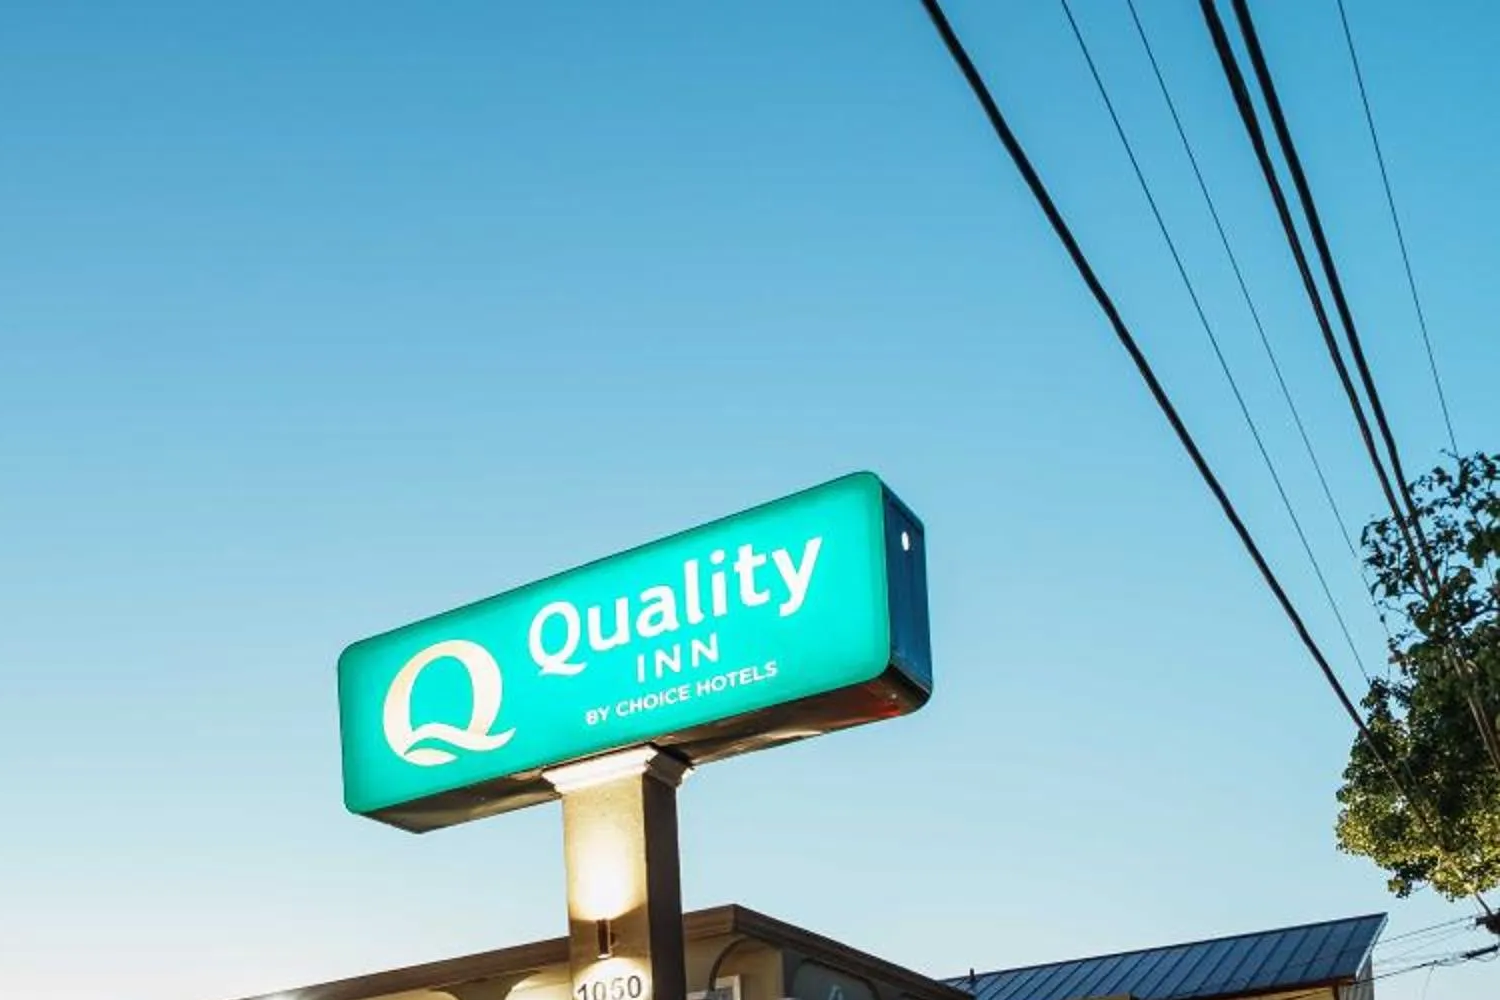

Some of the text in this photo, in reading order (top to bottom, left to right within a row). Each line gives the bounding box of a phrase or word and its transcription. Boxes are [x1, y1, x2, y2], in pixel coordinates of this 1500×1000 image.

[528, 536, 823, 676] Quality
[383, 639, 516, 767] Q
[585, 661, 778, 725] BY CHOICE HOTELS
[637, 632, 719, 683] INN
